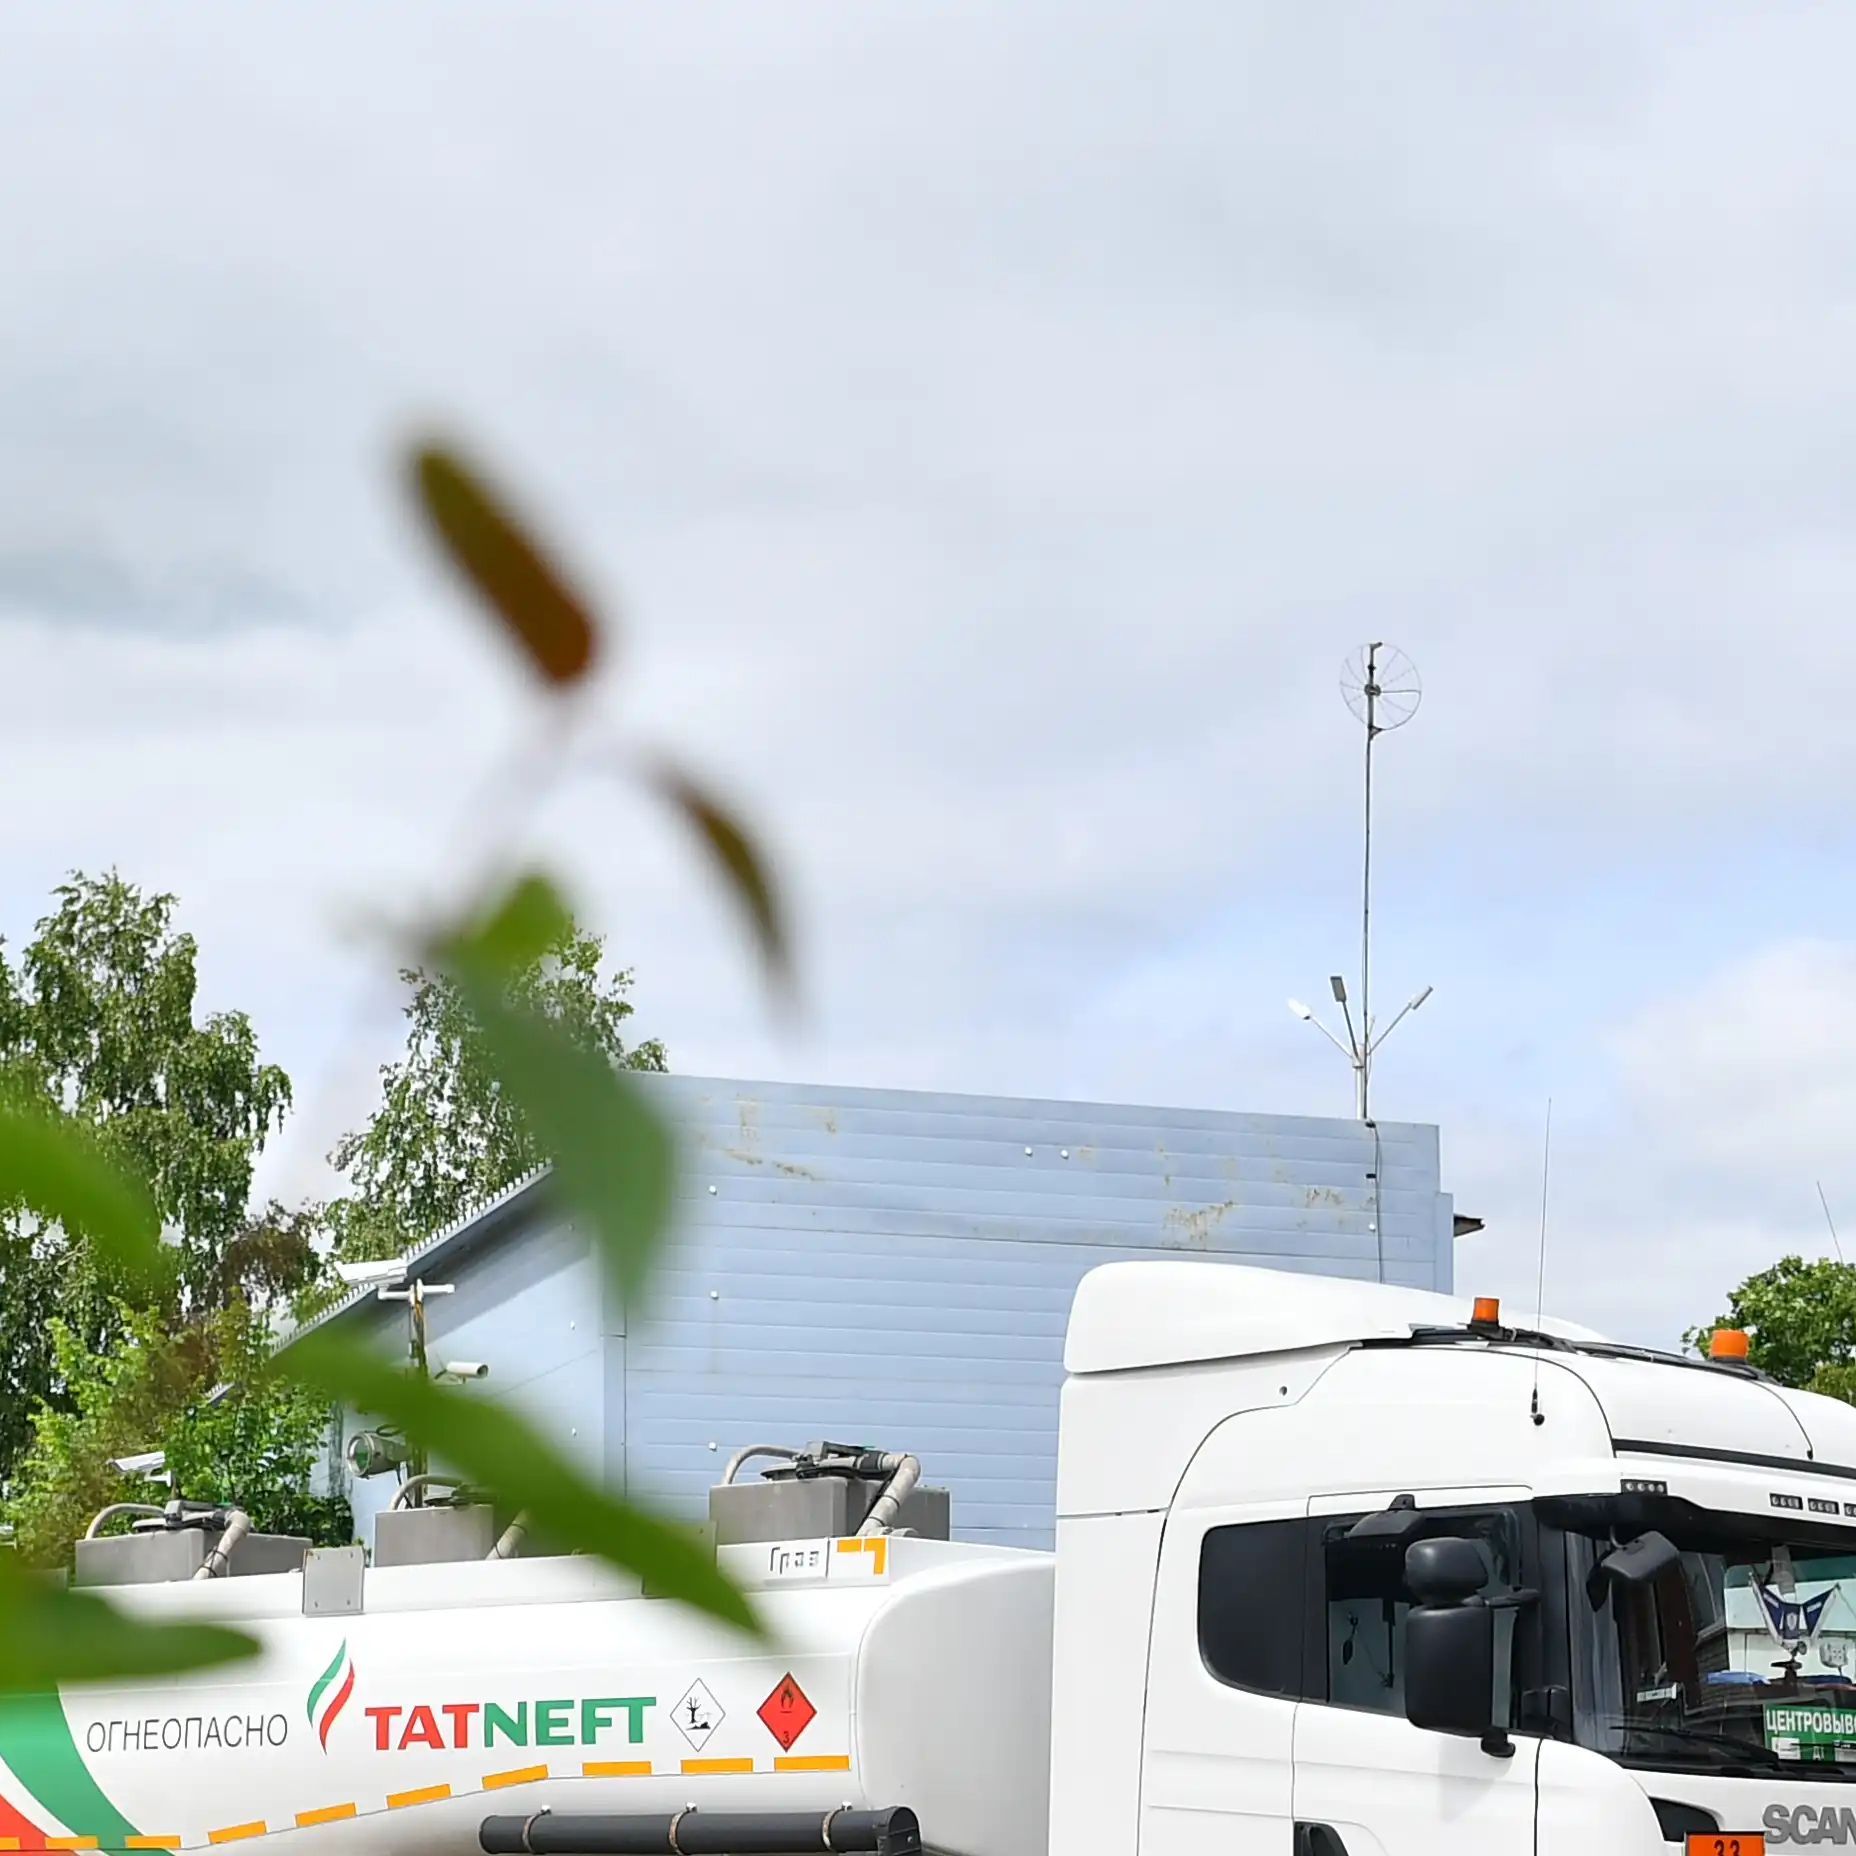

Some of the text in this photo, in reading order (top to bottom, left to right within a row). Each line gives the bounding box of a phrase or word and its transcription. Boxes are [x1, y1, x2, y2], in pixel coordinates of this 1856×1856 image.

[87, 1714, 288, 1753] ОГНЕОПАСНО
[365, 1697, 657, 1751] TATNEFT
[783, 1730, 790, 1744] 3
